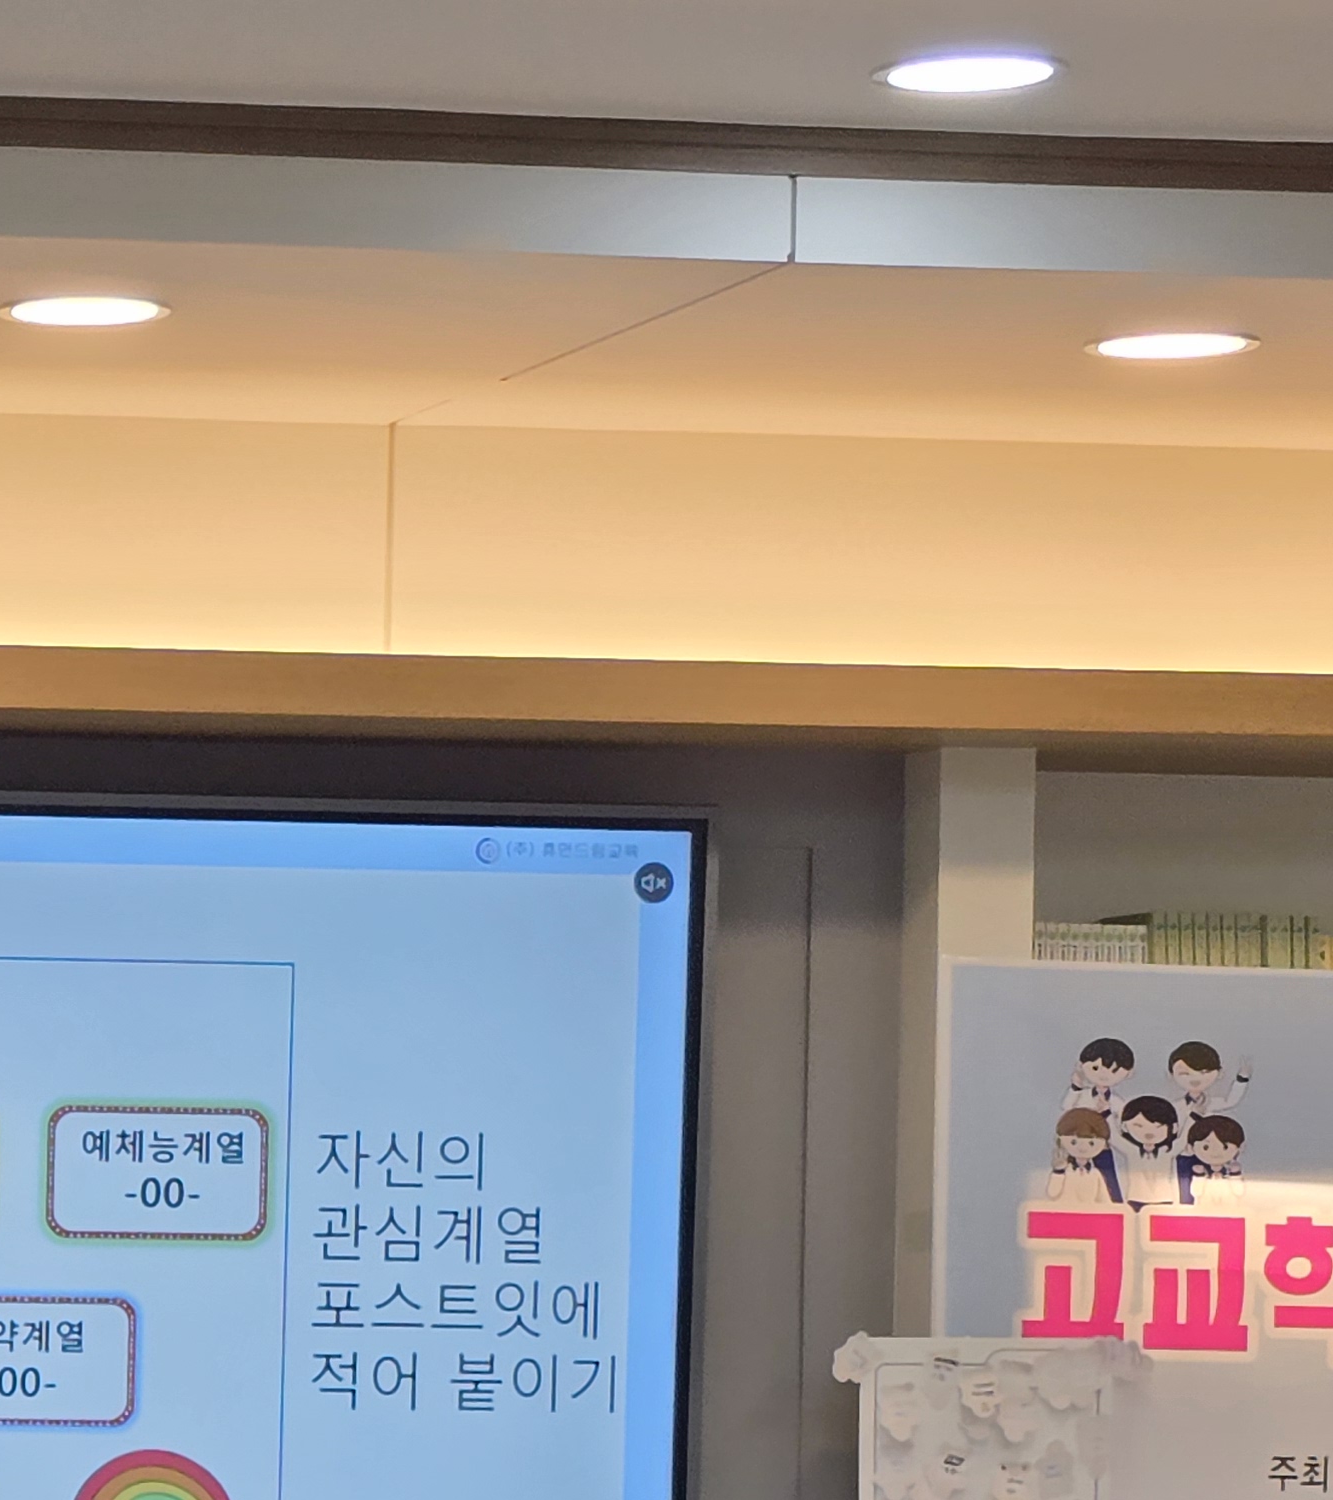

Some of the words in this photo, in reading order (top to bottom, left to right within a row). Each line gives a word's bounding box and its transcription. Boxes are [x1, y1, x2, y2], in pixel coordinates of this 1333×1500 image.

[81, 1128, 247, 1166] 예체능계열
[316, 1129, 486, 1191] 자신의
[312, 1203, 543, 1266] 관심계열
[310, 1278, 601, 1341] 포스트잇에
[310, 1351, 419, 1412] 적어
[449, 1353, 618, 1414] 붙이기
[1267, 1455, 1329, 1494] 주최
